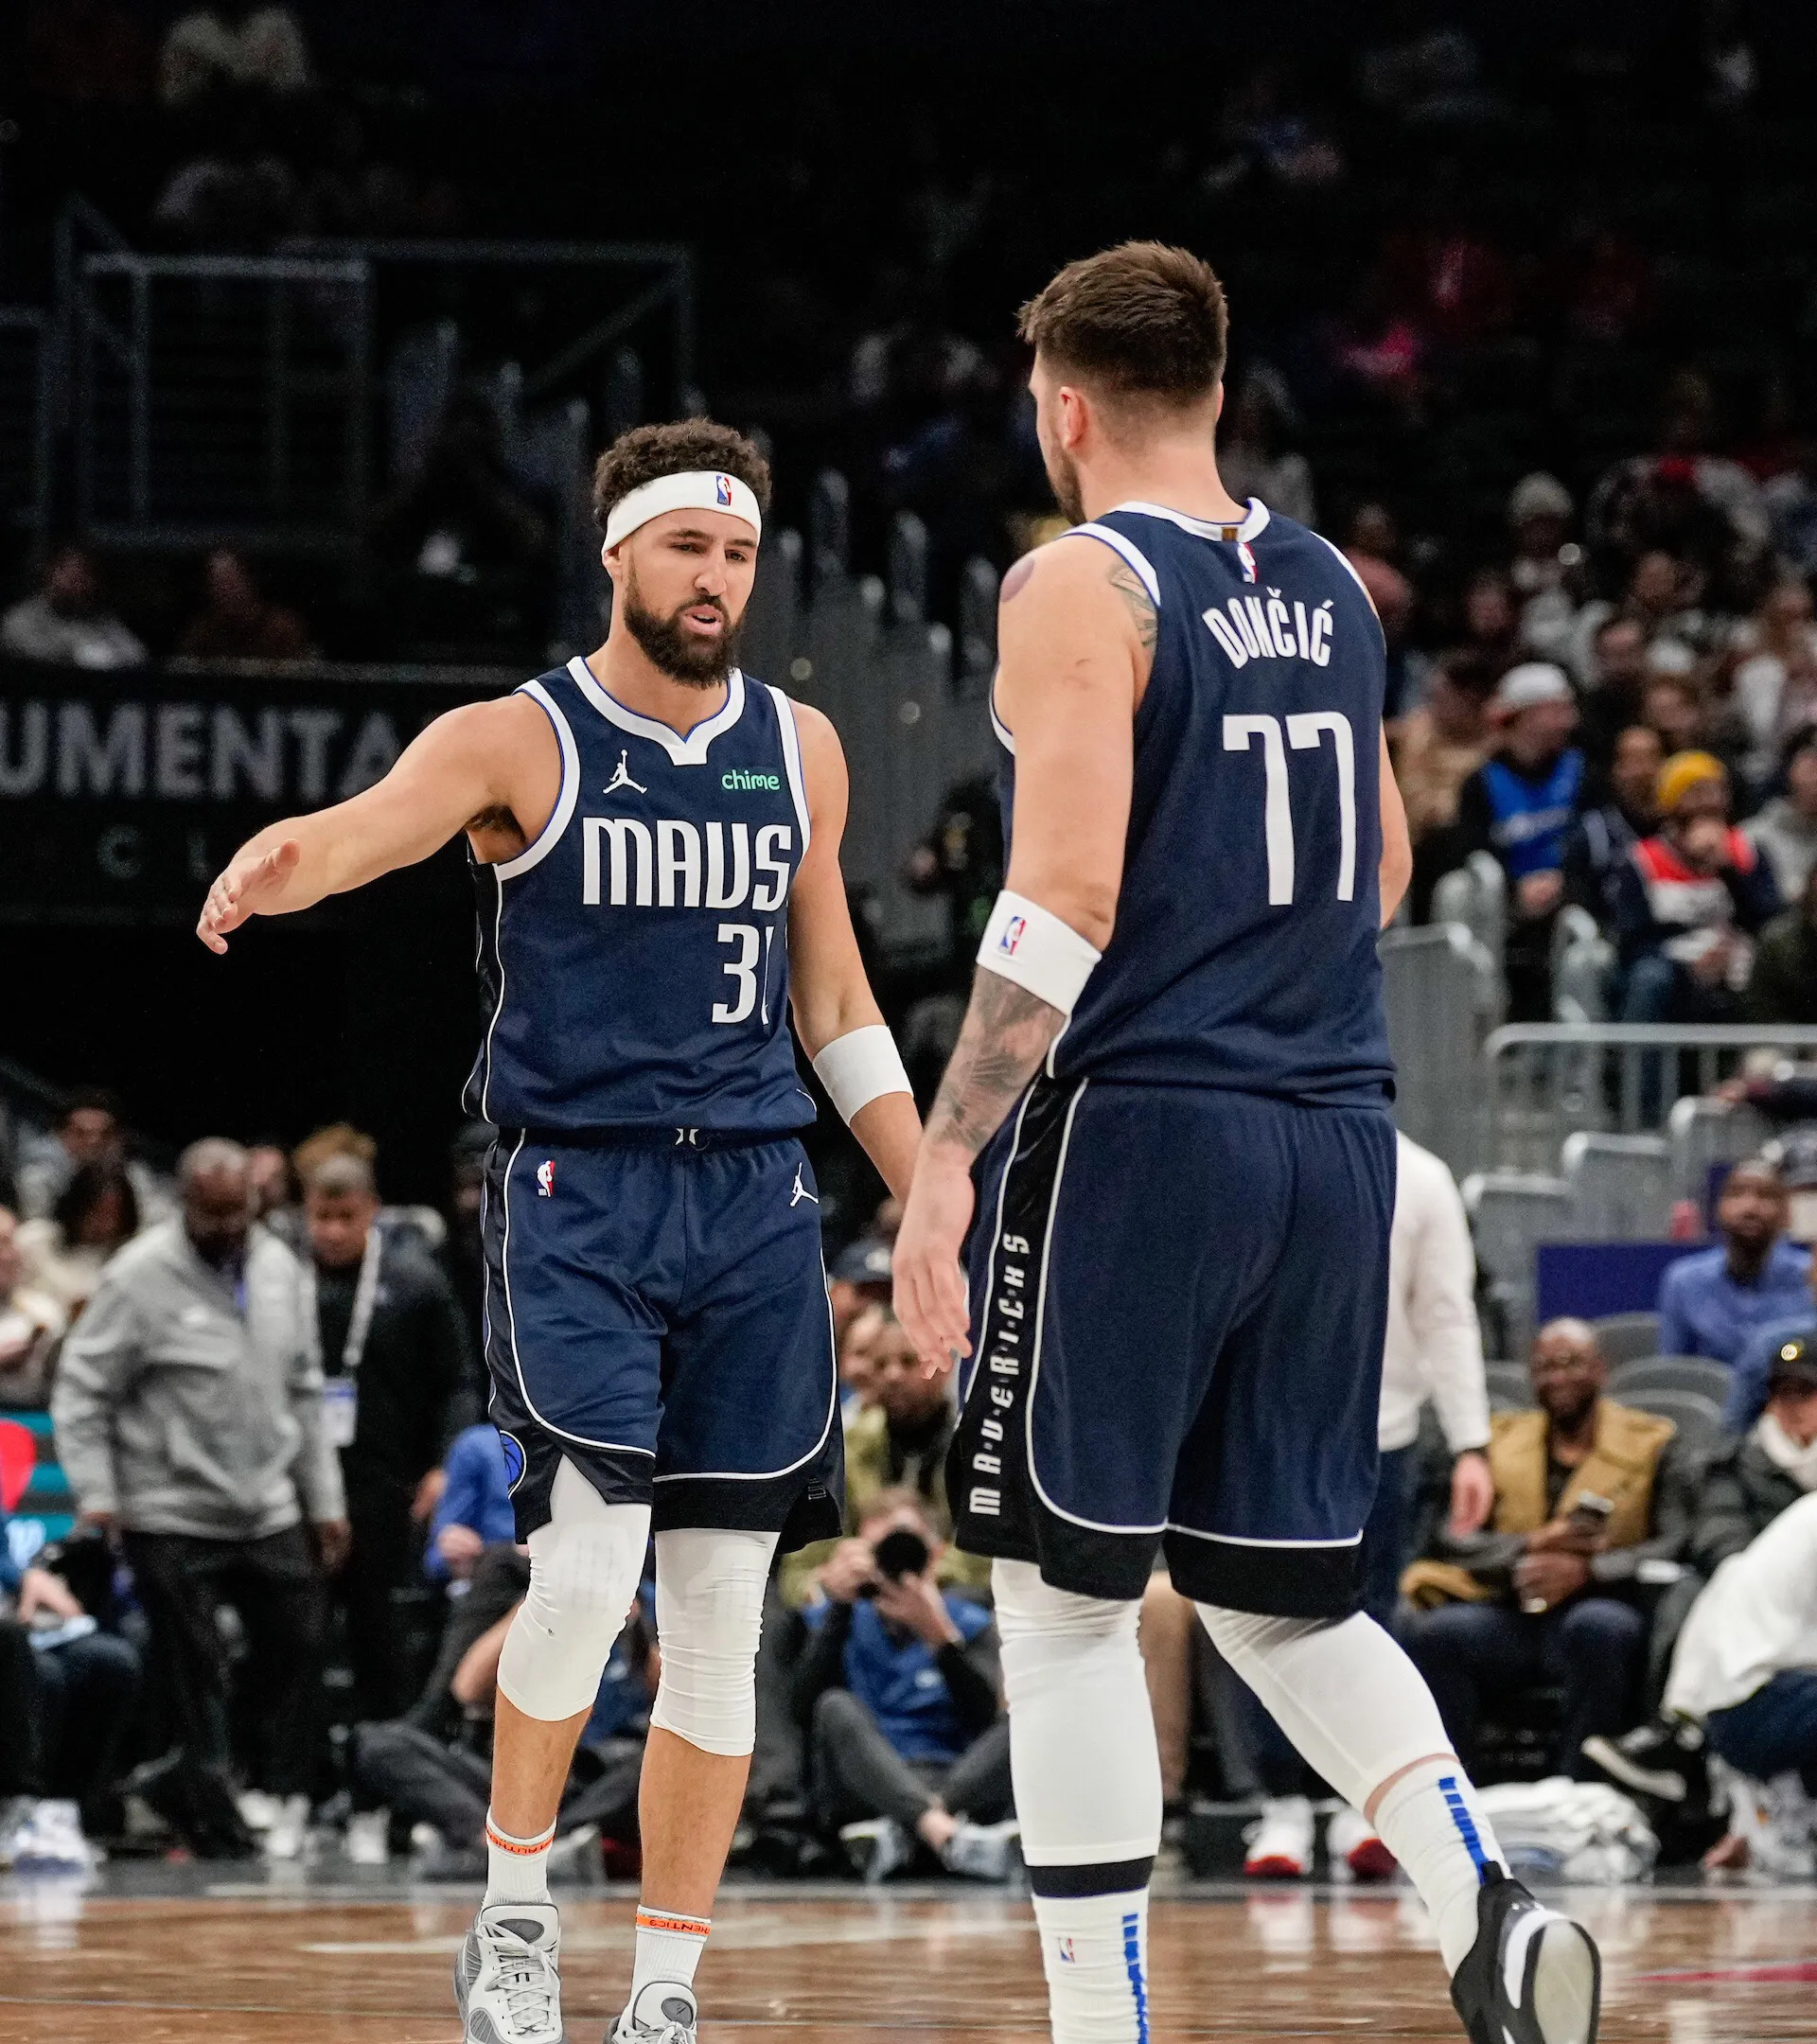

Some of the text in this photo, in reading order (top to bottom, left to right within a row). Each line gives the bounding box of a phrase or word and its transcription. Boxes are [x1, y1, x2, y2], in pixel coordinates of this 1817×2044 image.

[1202, 586, 1333, 669] DONČIĆ
[721, 769, 780, 791] chime
[1223, 712, 1356, 906] 77
[583, 817, 791, 911] MAVS
